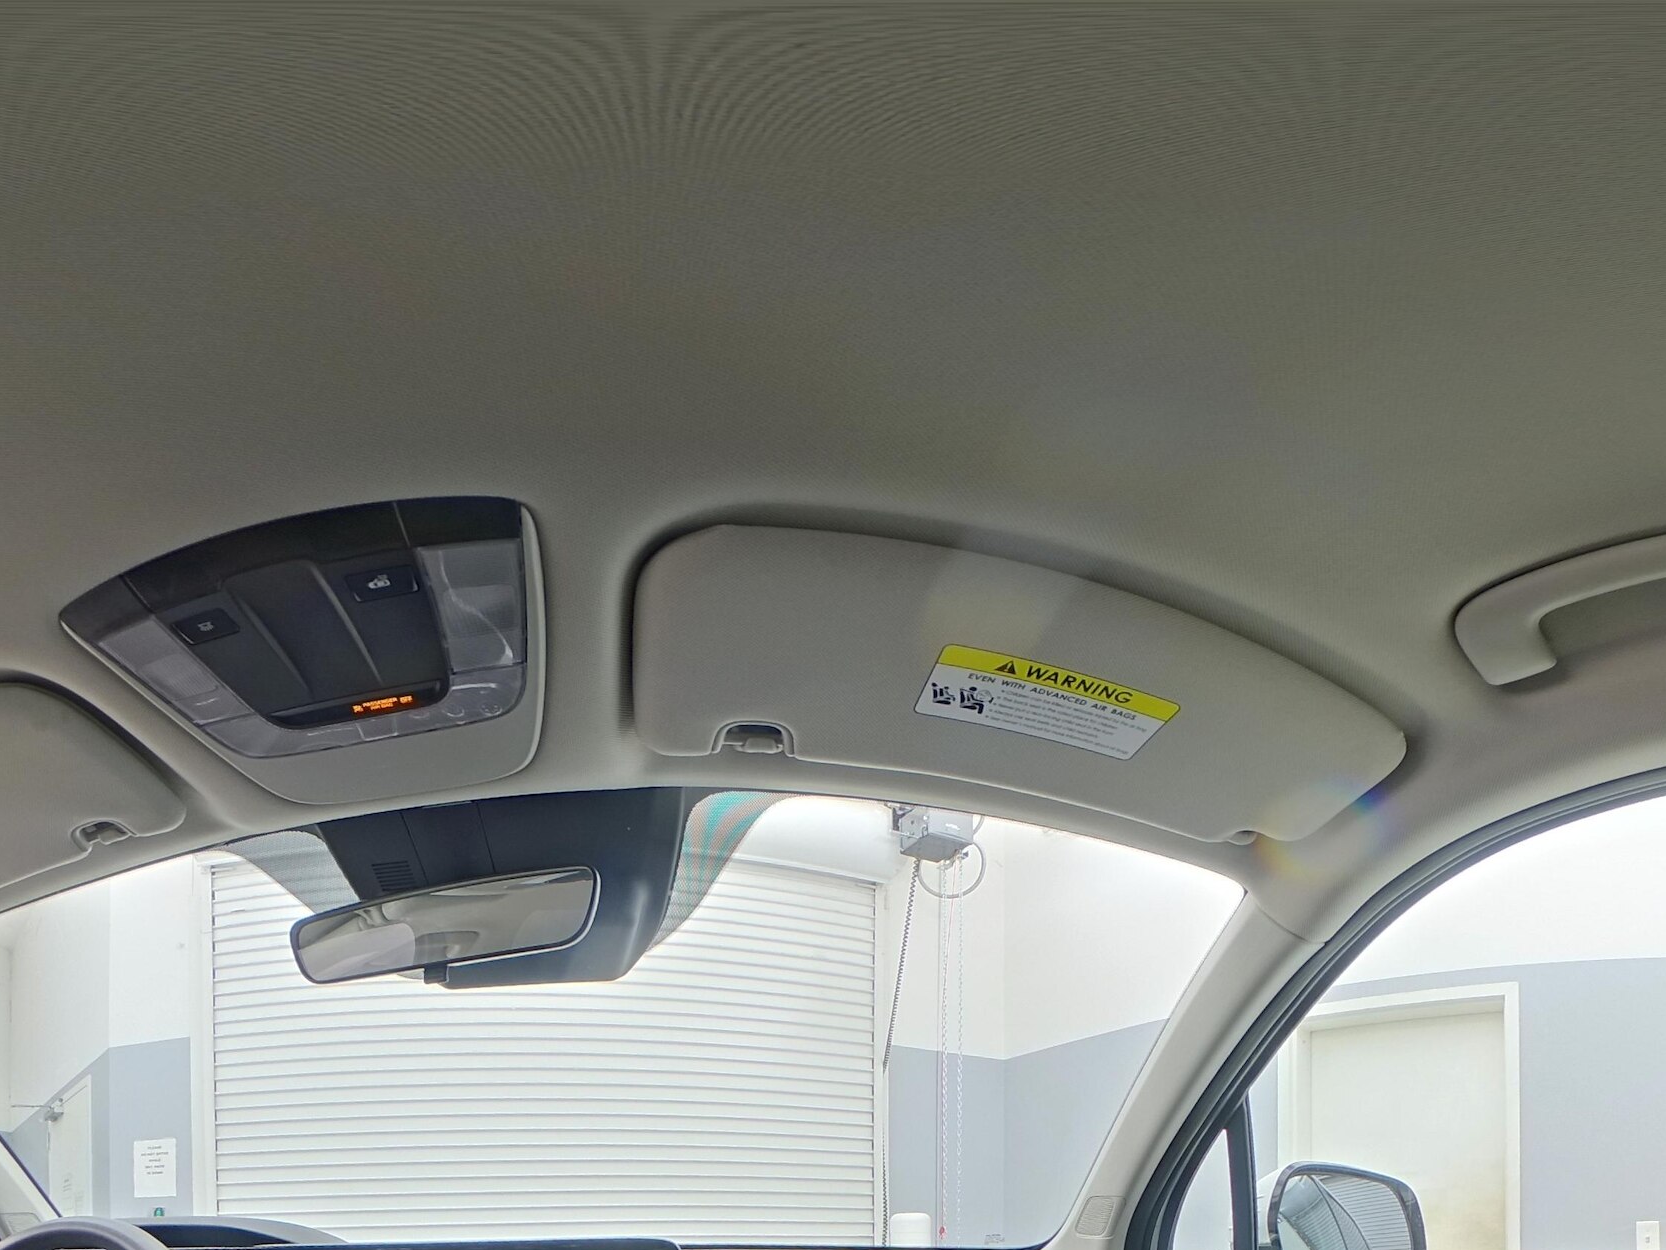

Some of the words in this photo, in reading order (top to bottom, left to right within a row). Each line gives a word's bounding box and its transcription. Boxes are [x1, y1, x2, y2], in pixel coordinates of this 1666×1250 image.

[968, 673, 996, 683] EVEN
[1002, 680, 1026, 690] WITH
[1030, 687, 1088, 706] ADVANCED
[1092, 703, 1108, 712] AIR
[1111, 709, 1136, 720] BAGS
[1026, 665, 1133, 703] WARNING
